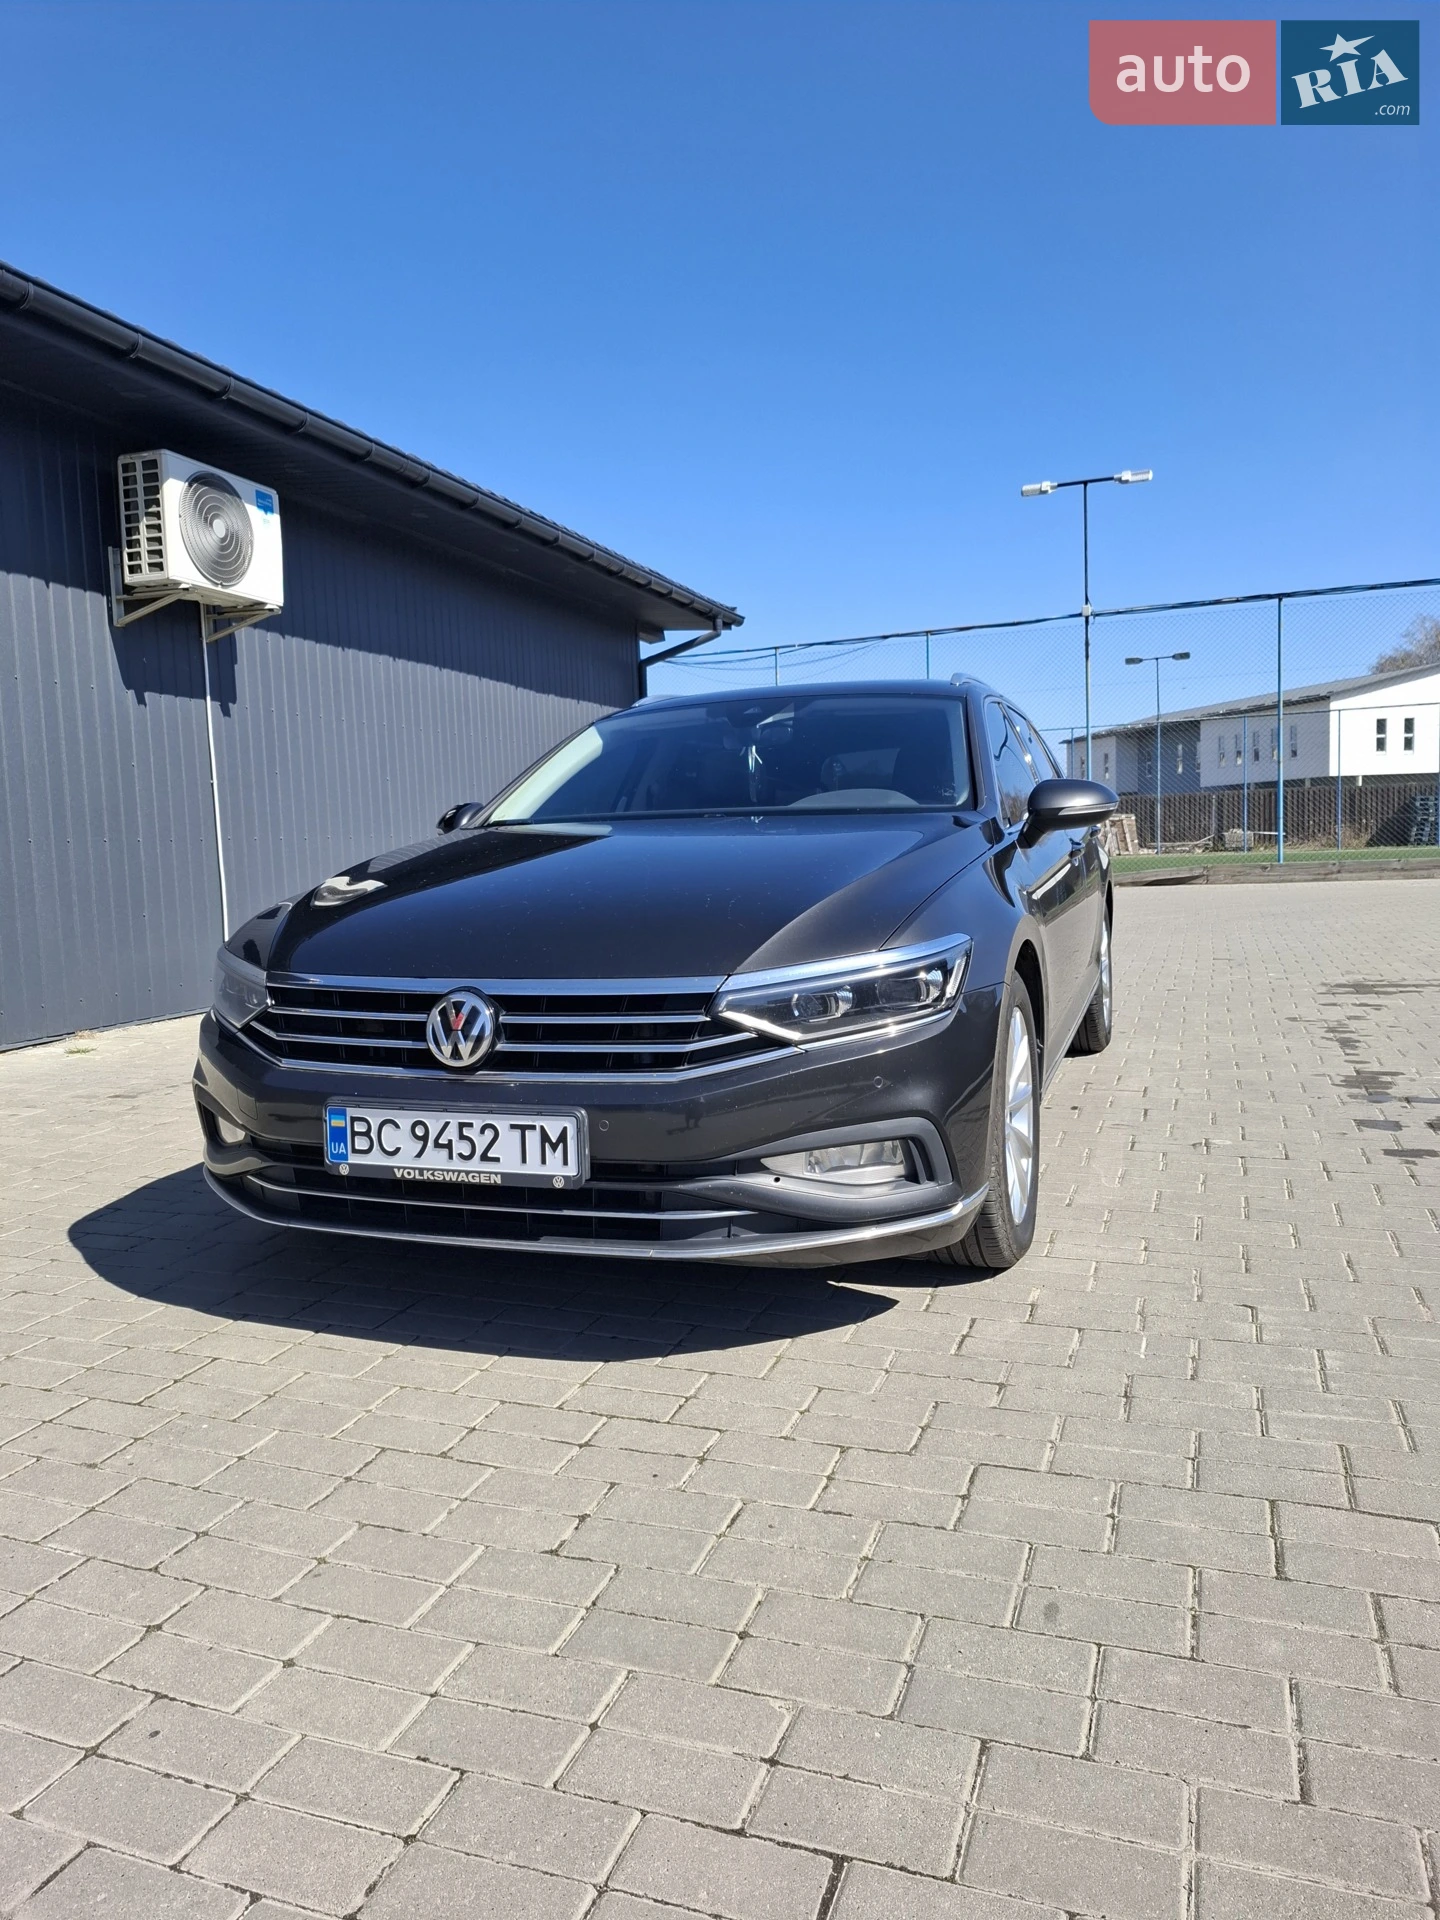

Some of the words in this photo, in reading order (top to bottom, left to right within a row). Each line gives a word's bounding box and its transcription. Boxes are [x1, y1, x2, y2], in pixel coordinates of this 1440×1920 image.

[331, 1142, 346, 1155] UA
[350, 1115, 402, 1157] BC
[410, 1119, 501, 1163] 9452
[510, 1123, 569, 1167] TM
[393, 1168, 502, 1184] VOLKSWAGEN
